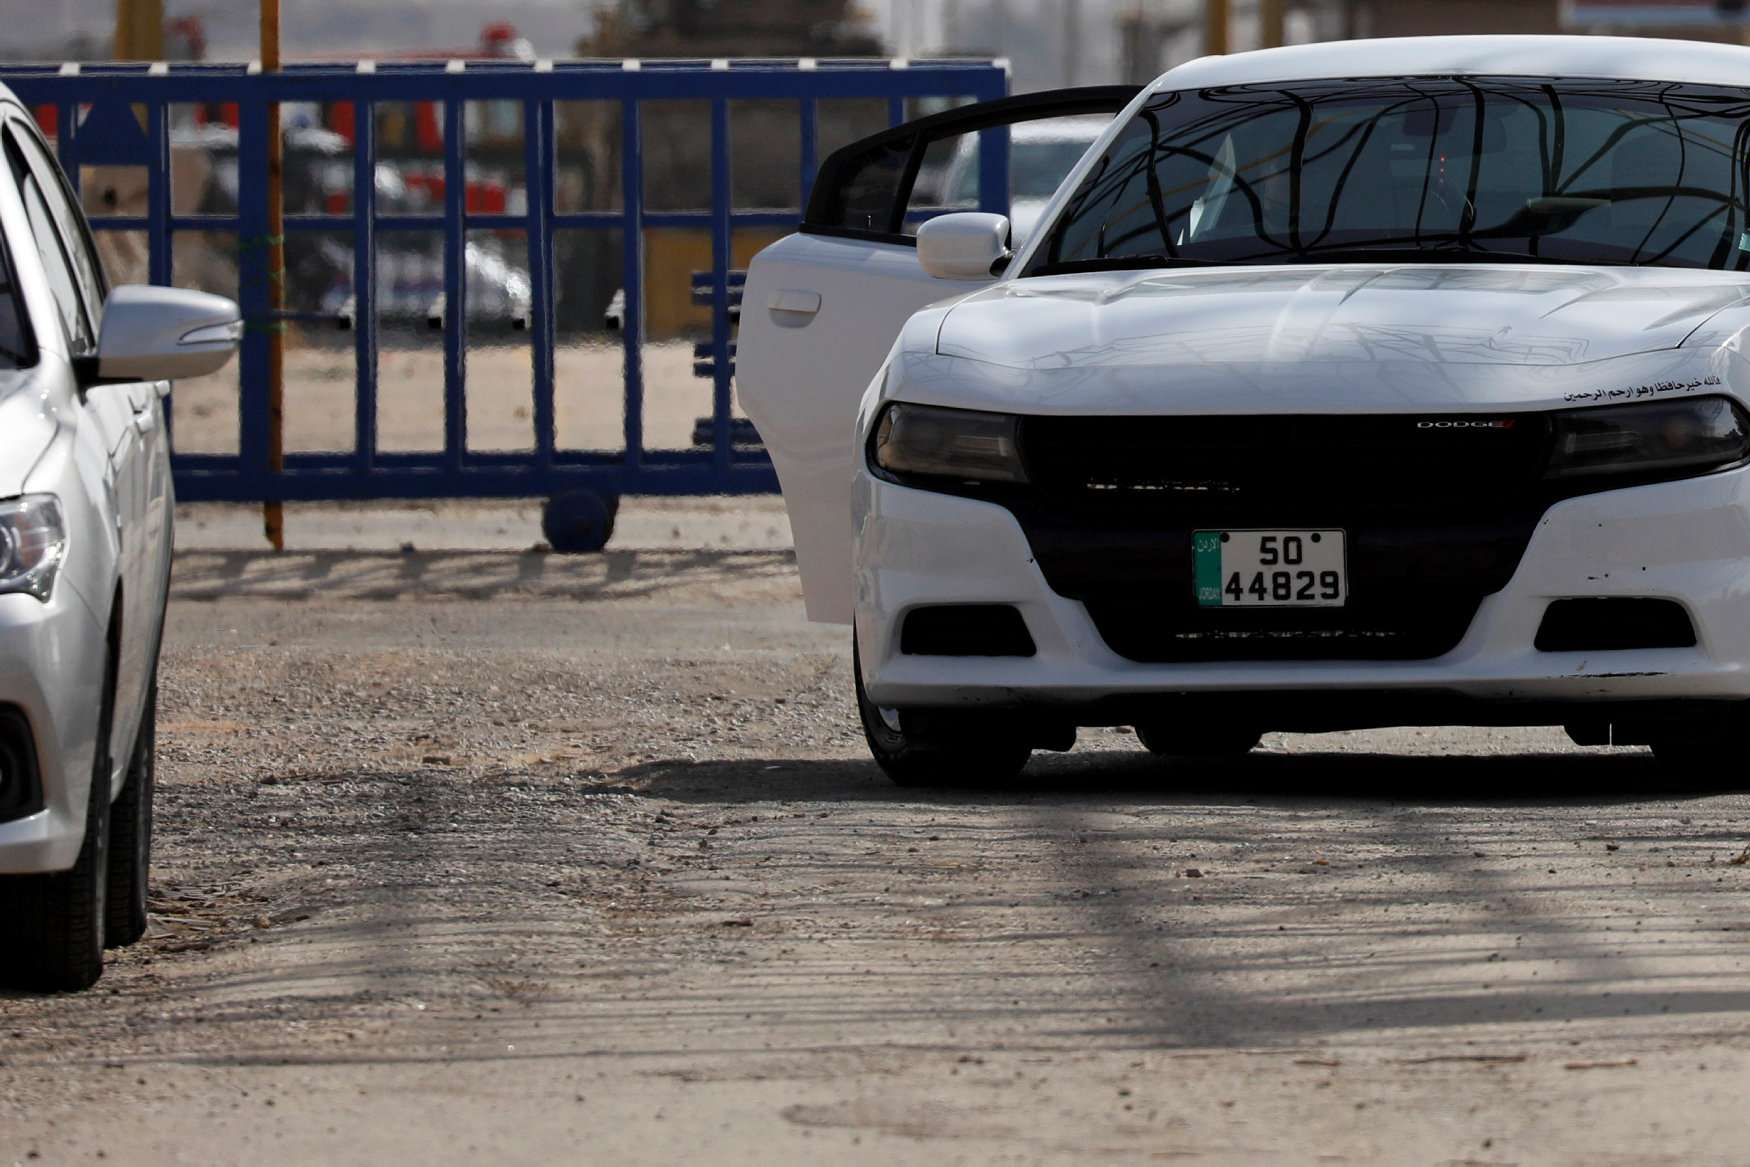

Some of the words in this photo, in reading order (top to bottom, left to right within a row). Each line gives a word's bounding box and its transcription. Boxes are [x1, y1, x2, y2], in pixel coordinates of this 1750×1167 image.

[1656, 380, 1685, 392] حافظا
[1685, 378, 1701, 391] خير
[1636, 385, 1655, 397] وهو
[1417, 420, 1505, 429] DODGE
[1259, 536, 1302, 565] 50
[1225, 571, 1340, 601] 44829
